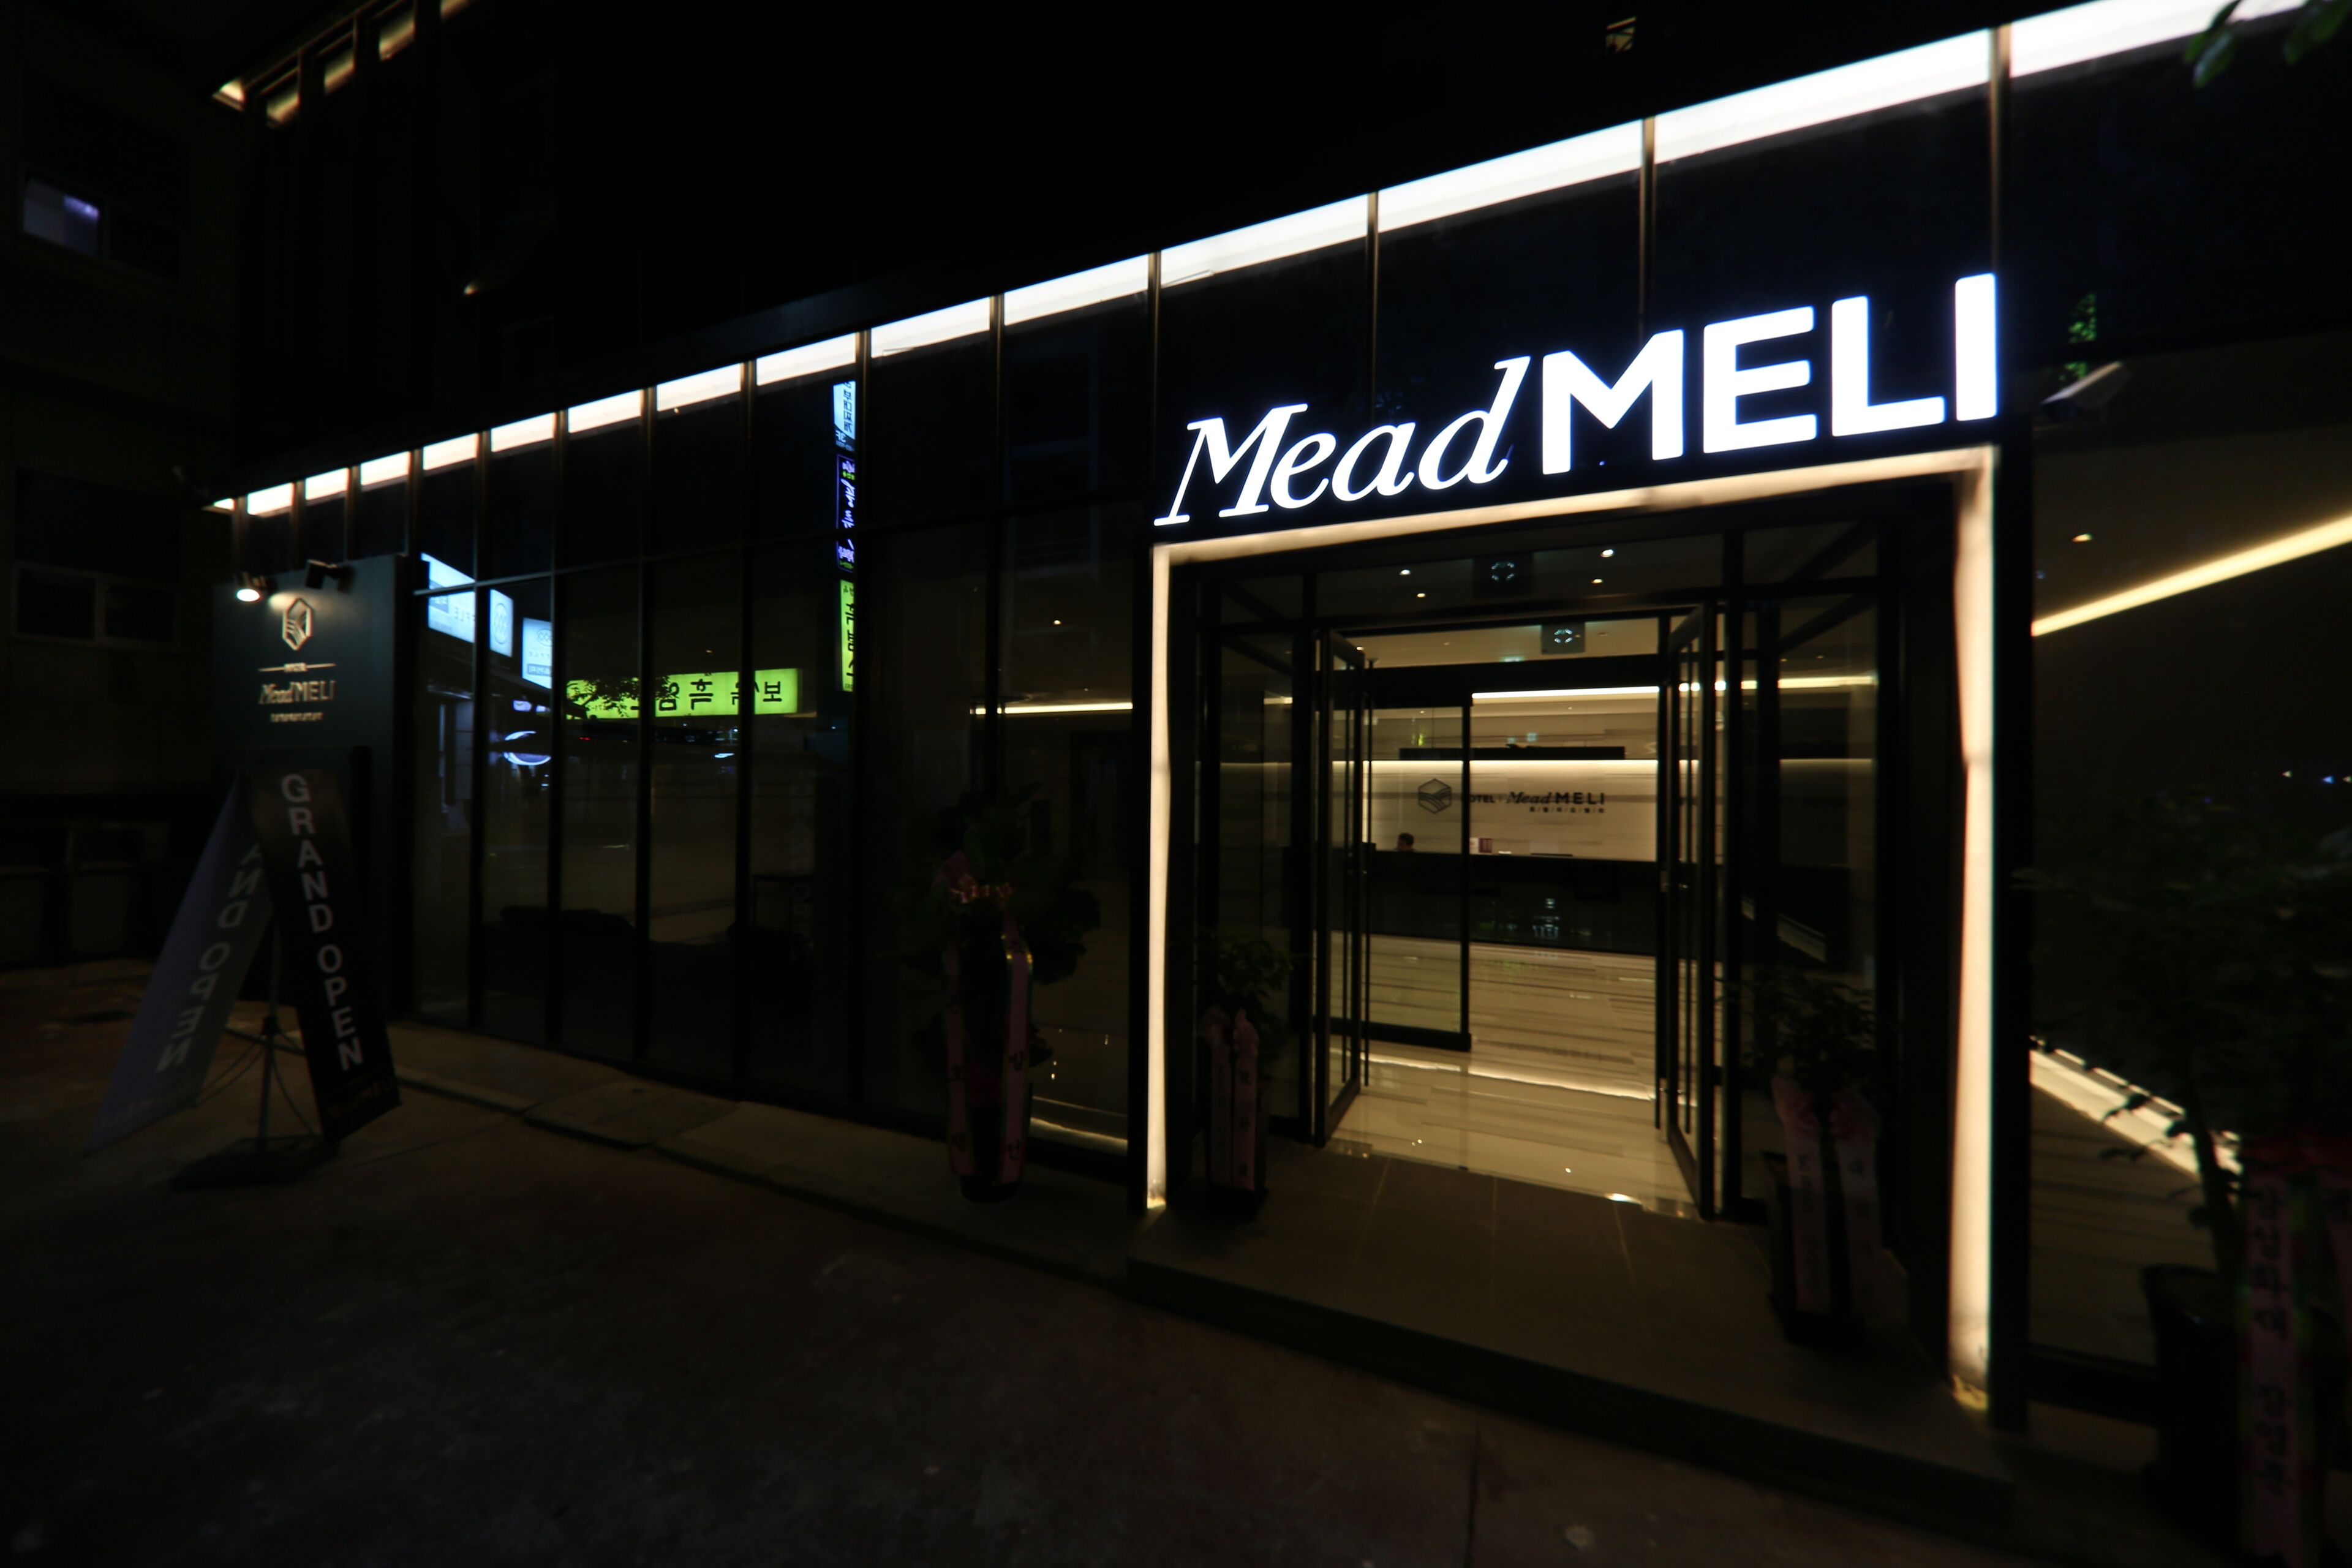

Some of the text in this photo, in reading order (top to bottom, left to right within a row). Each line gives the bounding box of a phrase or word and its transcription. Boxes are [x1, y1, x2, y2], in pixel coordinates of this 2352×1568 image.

[1469, 794, 1495, 804] OTEL
[281, 773, 335, 935] GRAND
[315, 943, 364, 1072] OPEN
